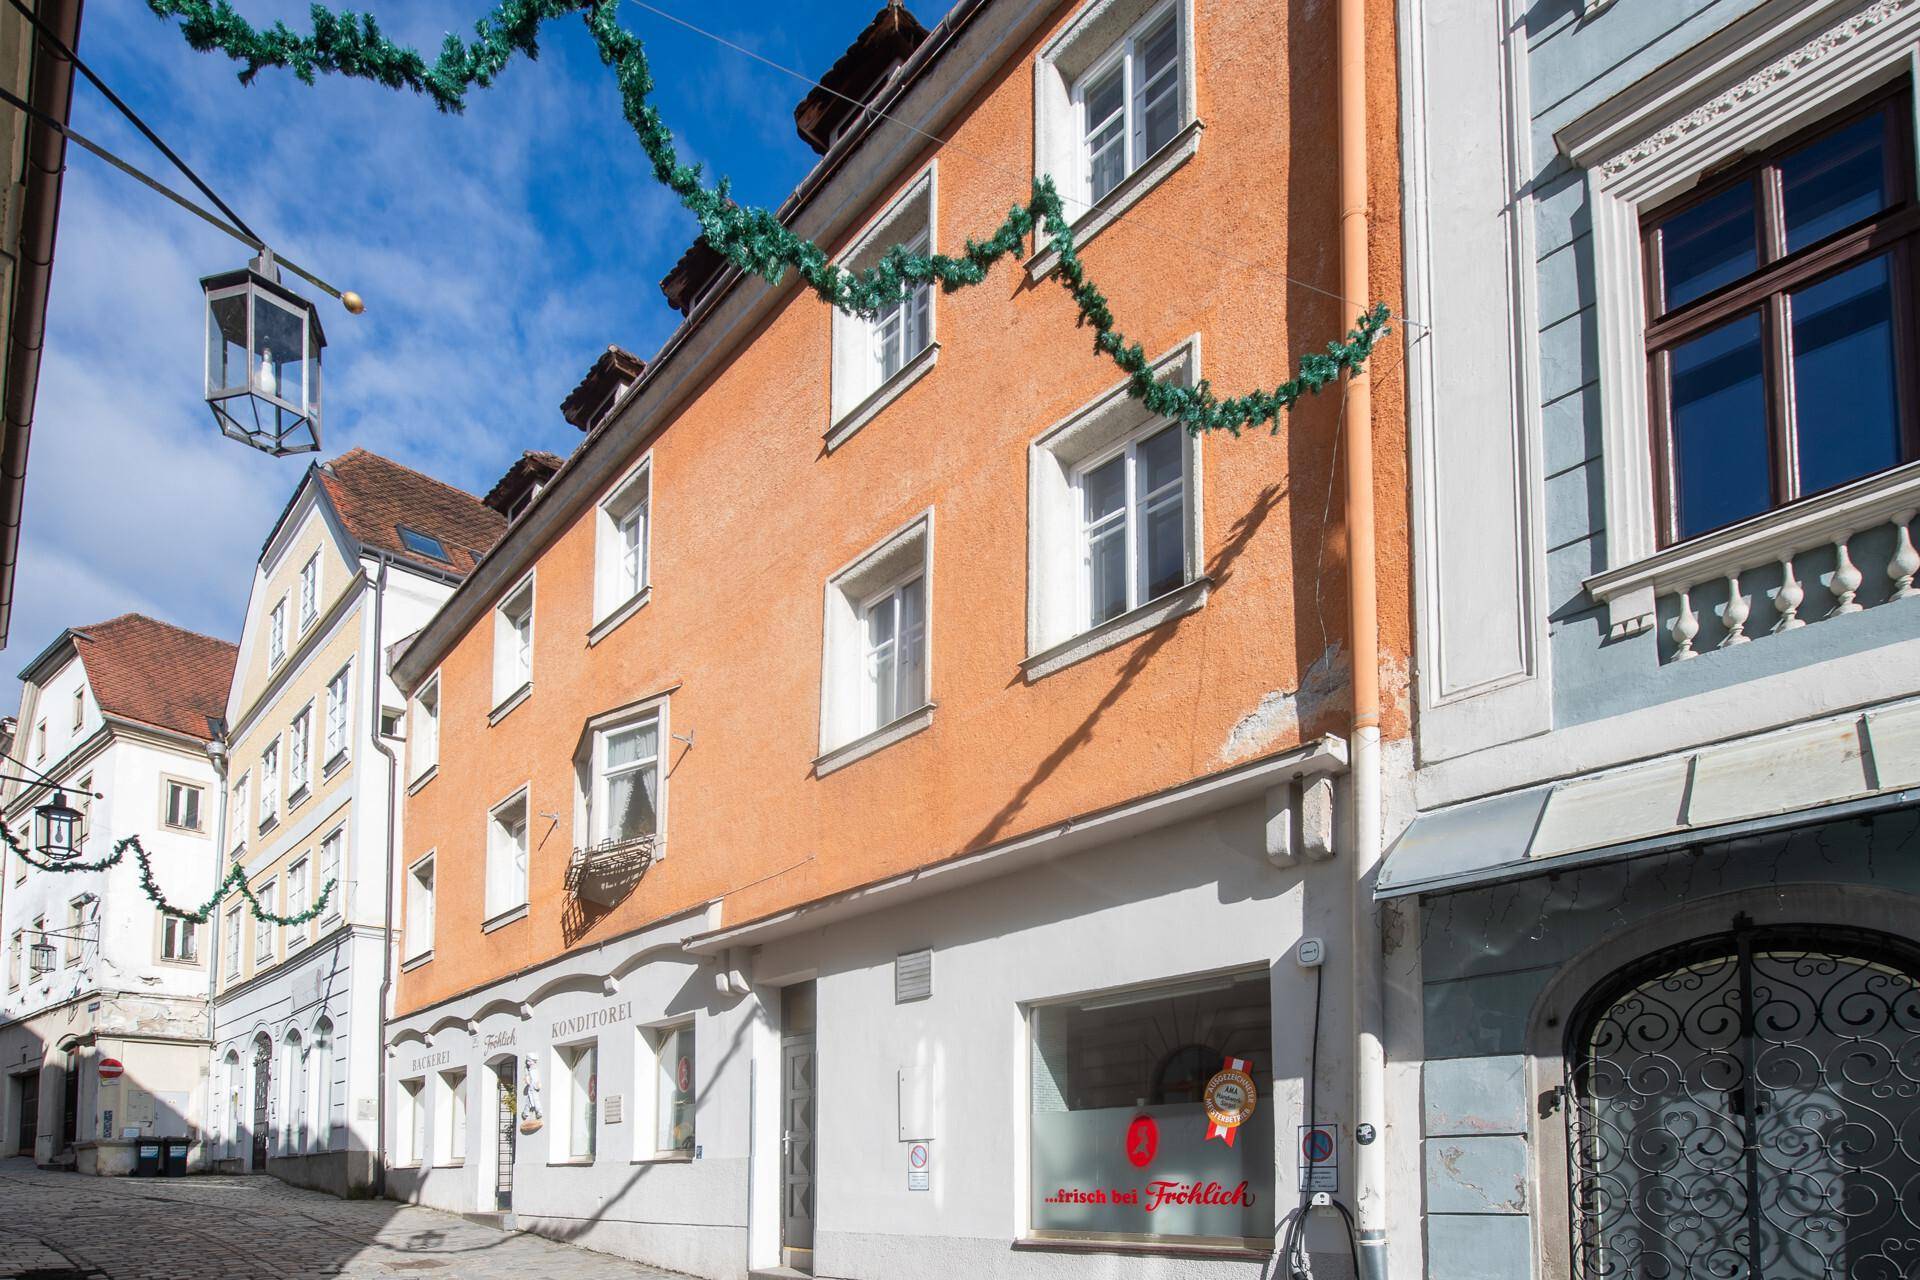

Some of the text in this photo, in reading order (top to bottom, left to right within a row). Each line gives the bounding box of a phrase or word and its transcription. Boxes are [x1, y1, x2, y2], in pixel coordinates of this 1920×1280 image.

[551, 1001, 633, 1039] KONDITOREI
[1206, 1098, 1250, 1123] MEISTERBETRIEB
[1111, 1188, 1138, 1204] bei
[1145, 1180, 1256, 1212] Fröhlich
